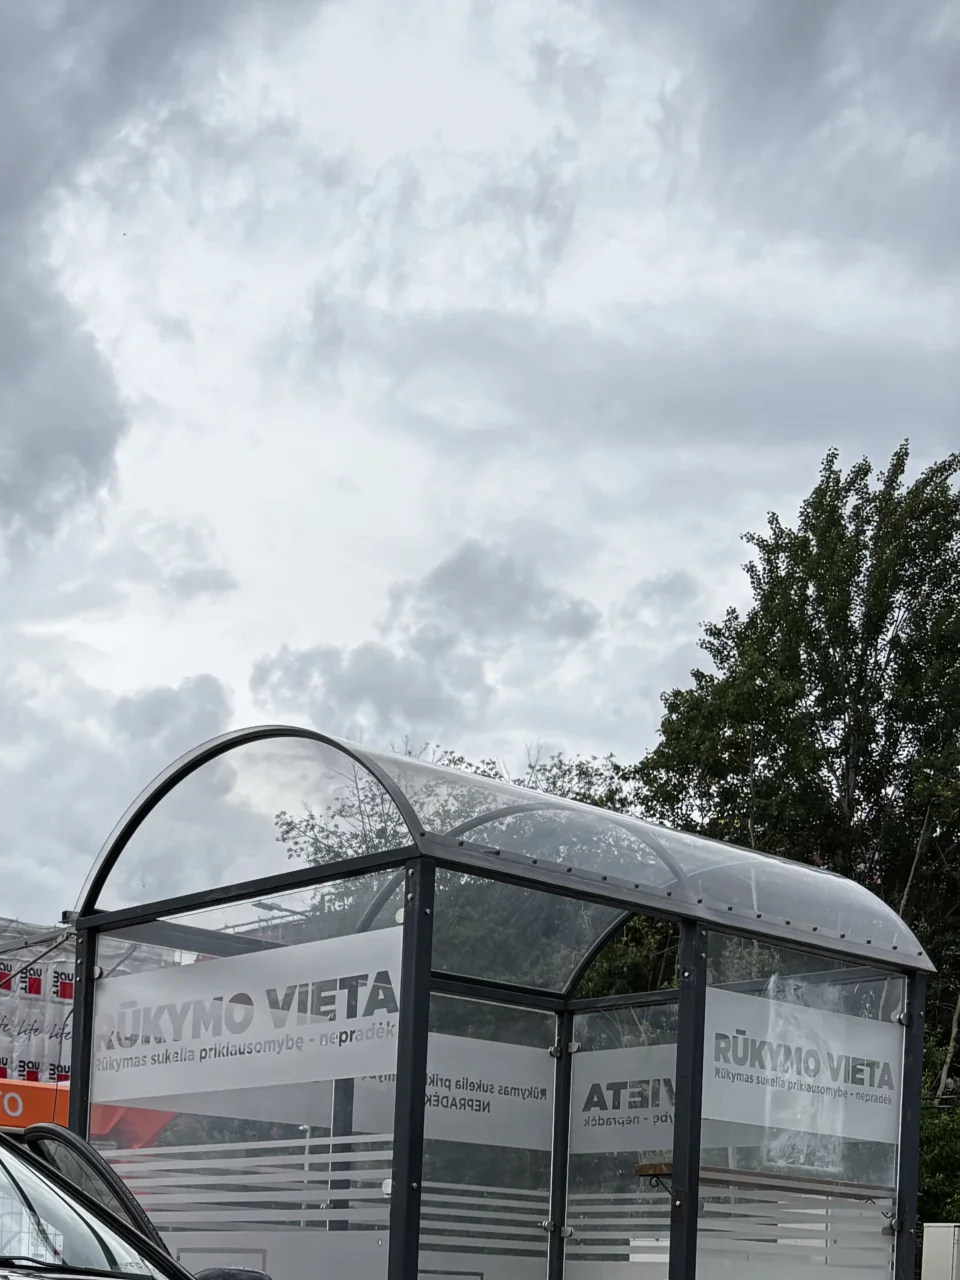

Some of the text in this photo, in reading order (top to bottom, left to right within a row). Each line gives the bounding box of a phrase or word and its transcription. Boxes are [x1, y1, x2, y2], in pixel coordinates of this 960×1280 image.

[95, 970, 400, 1052] RŪKYMO VIETA
[95, 1052, 147, 1073] Rūkymas
[150, 1046, 195, 1066] sukelia
[199, 1034, 304, 1062] priklausomybę
[714, 1028, 894, 1090] RŪKYMO VIETA
[714, 1066, 754, 1084] Rūkymas
[755, 1075, 785, 1089] sukelia
[787, 1081, 848, 1100] priklausomybę
[856, 1091, 893, 1106] nepradėk
